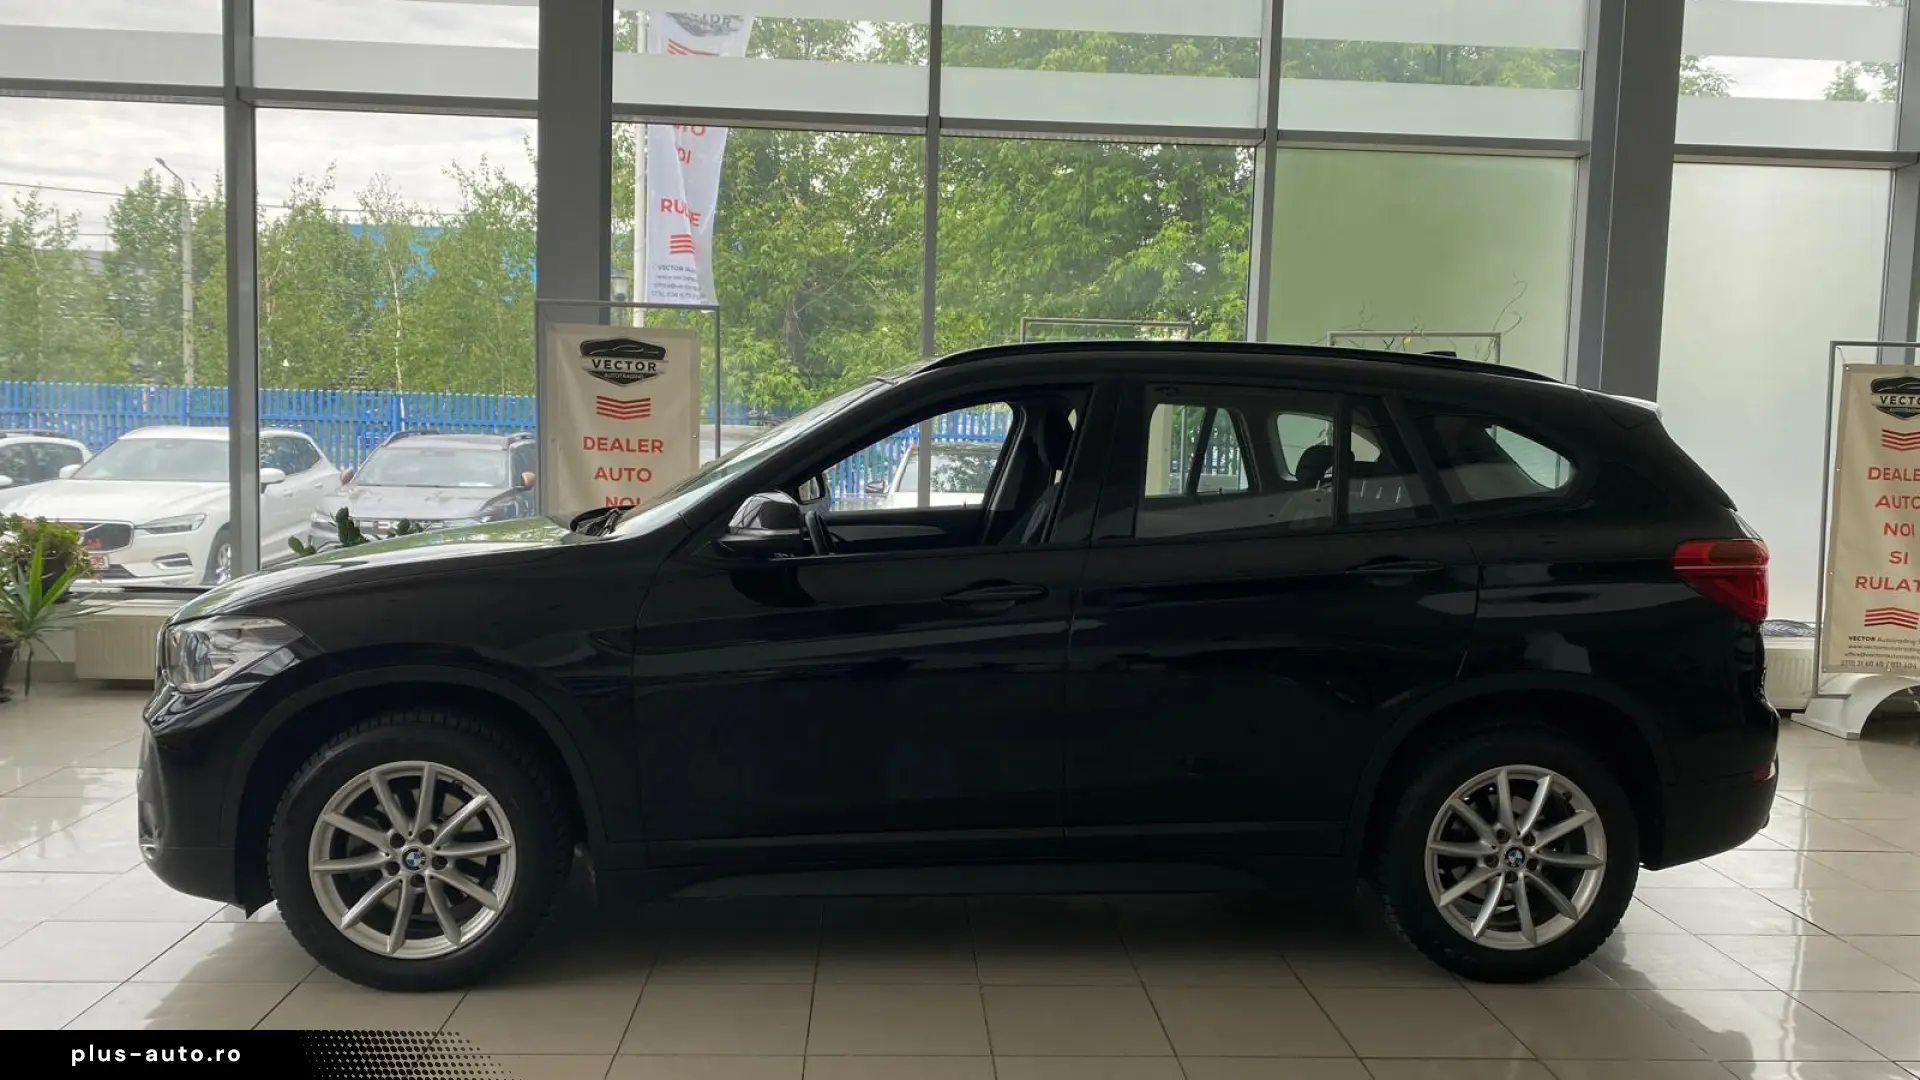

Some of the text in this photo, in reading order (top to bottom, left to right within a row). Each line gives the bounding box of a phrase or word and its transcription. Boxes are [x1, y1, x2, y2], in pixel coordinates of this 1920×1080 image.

[592, 358, 657, 372] VECTOR
[583, 436, 664, 453] DEALER
[594, 467, 652, 483] AUTO
[1884, 522, 1915, 537] NOI
[1888, 550, 1909, 565] SI
